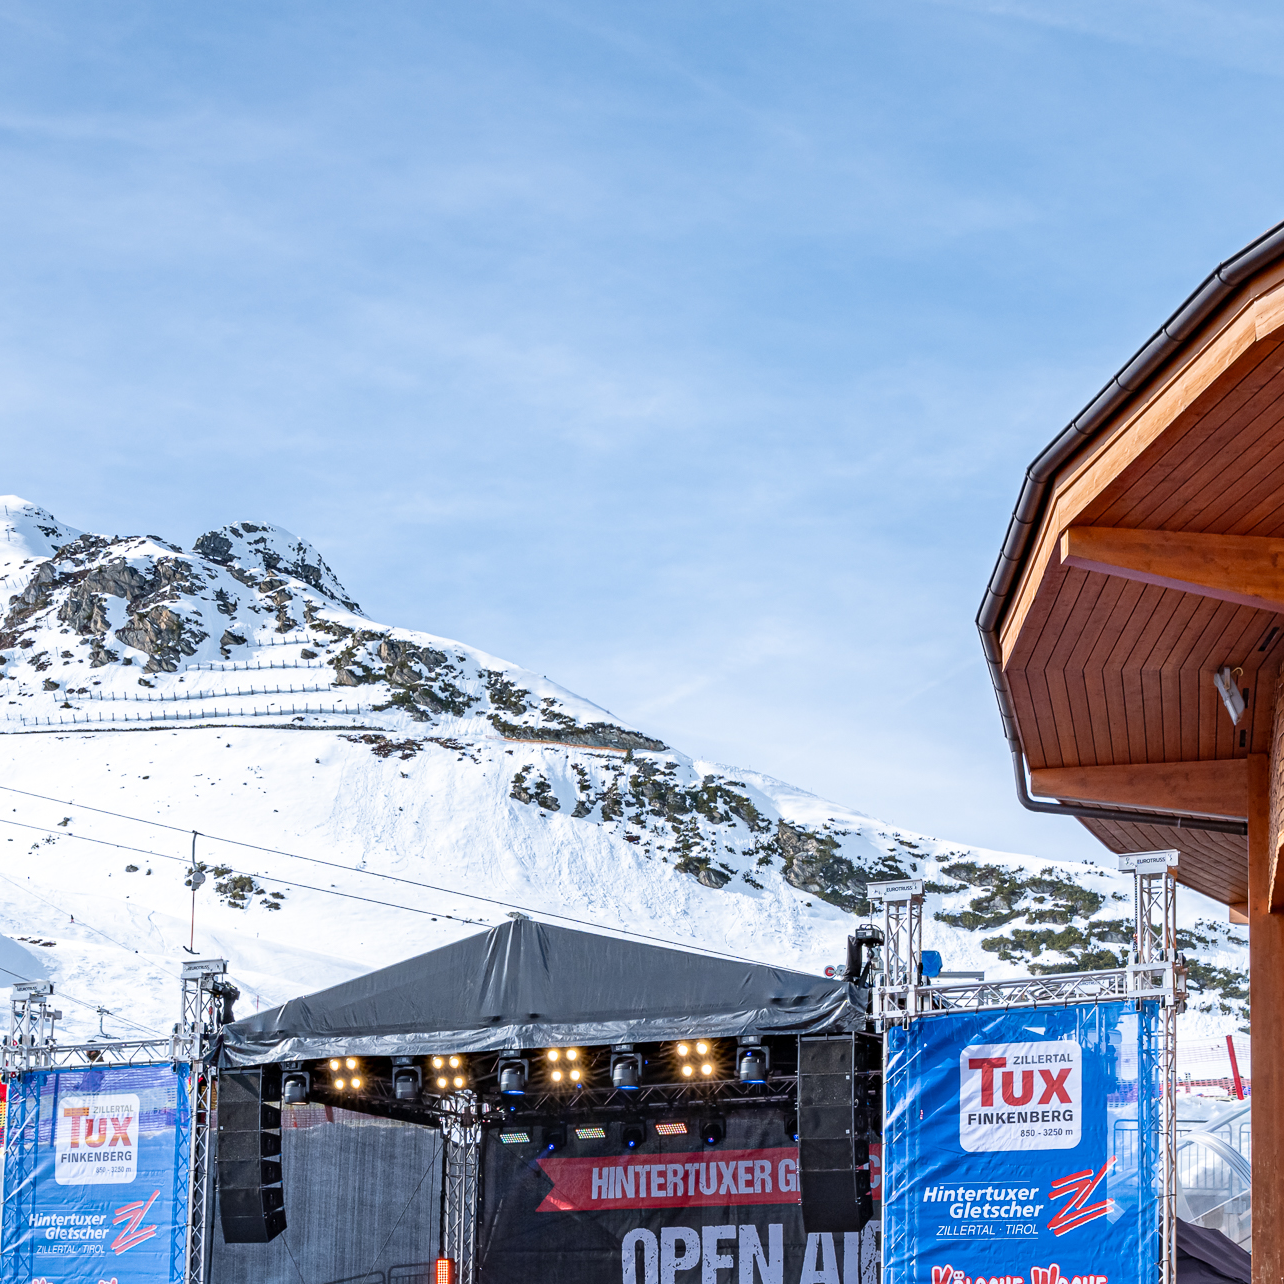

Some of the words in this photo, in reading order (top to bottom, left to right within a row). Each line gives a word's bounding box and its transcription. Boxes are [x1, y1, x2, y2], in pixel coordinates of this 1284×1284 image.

[1013, 1054, 1074, 1066] ZILLERTAL
[968, 1057, 1073, 1108] TUX
[93, 1104, 134, 1115] ZILLERTAL
[967, 1109, 1074, 1126] FINKENBERG
[63, 1106, 133, 1149] TUX
[1020, 1129, 1036, 1139] 850
[1043, 1128, 1063, 1138] 3250
[60, 1151, 133, 1164] FINKENBERG
[591, 1159, 773, 1200] HINTERTUXER
[923, 1185, 1040, 1202] Hintertuxer
[949, 1201, 1045, 1219] Gletscher
[28, 1213, 107, 1228] Hintertuxer
[45, 1226, 110, 1241] Gletscher
[935, 1225, 996, 1237] ZILLERTAL
[1006, 1224, 1039, 1235] TIROL
